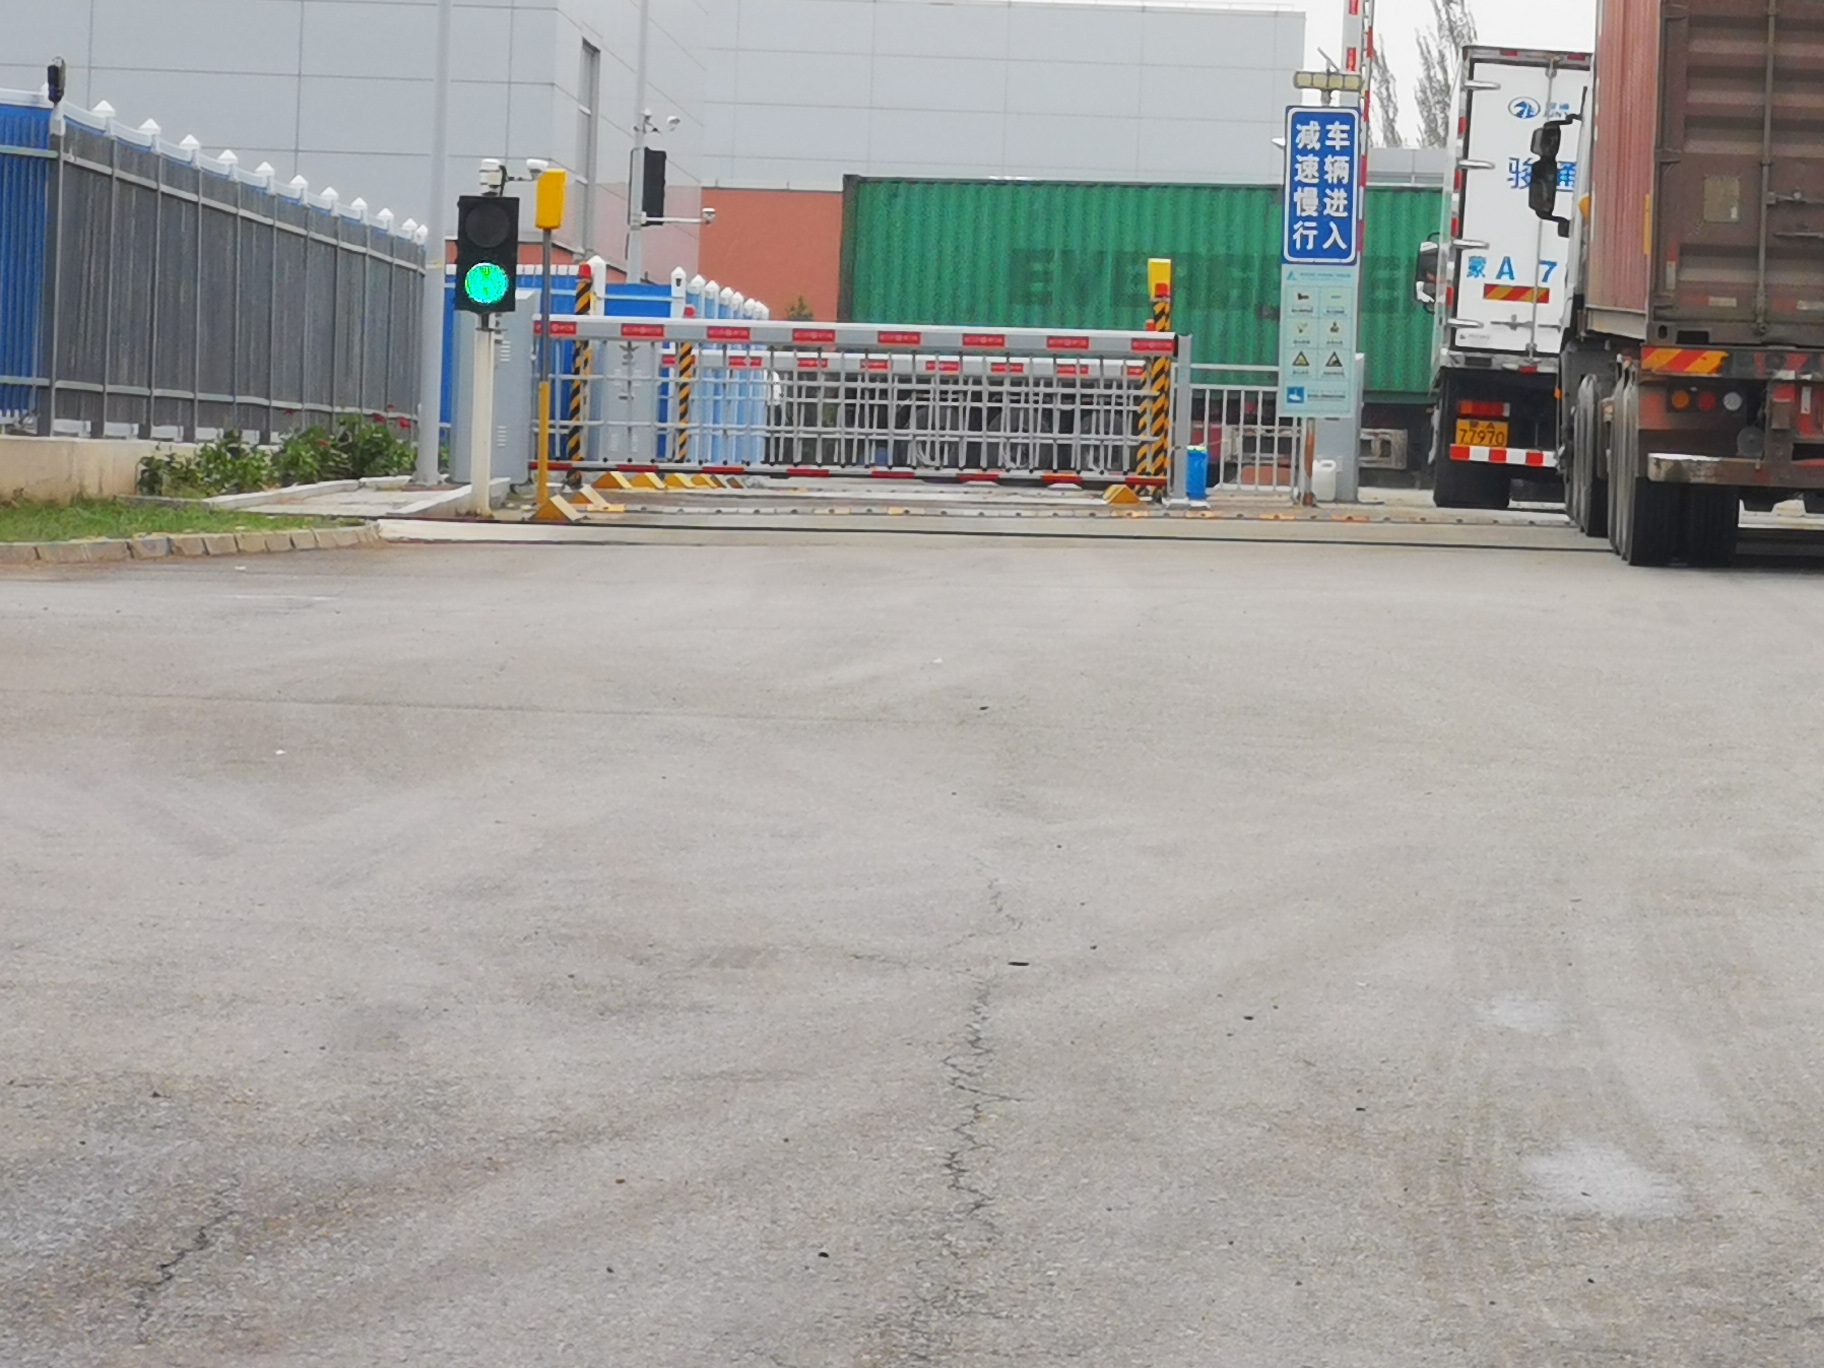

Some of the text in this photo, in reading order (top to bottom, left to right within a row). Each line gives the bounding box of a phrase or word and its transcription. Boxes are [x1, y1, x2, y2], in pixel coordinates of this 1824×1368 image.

[1293, 120, 1321, 250] 减速慢行
[1322, 120, 1351, 250] 车辆进入
[1459, 429, 1504, 444] 77970
